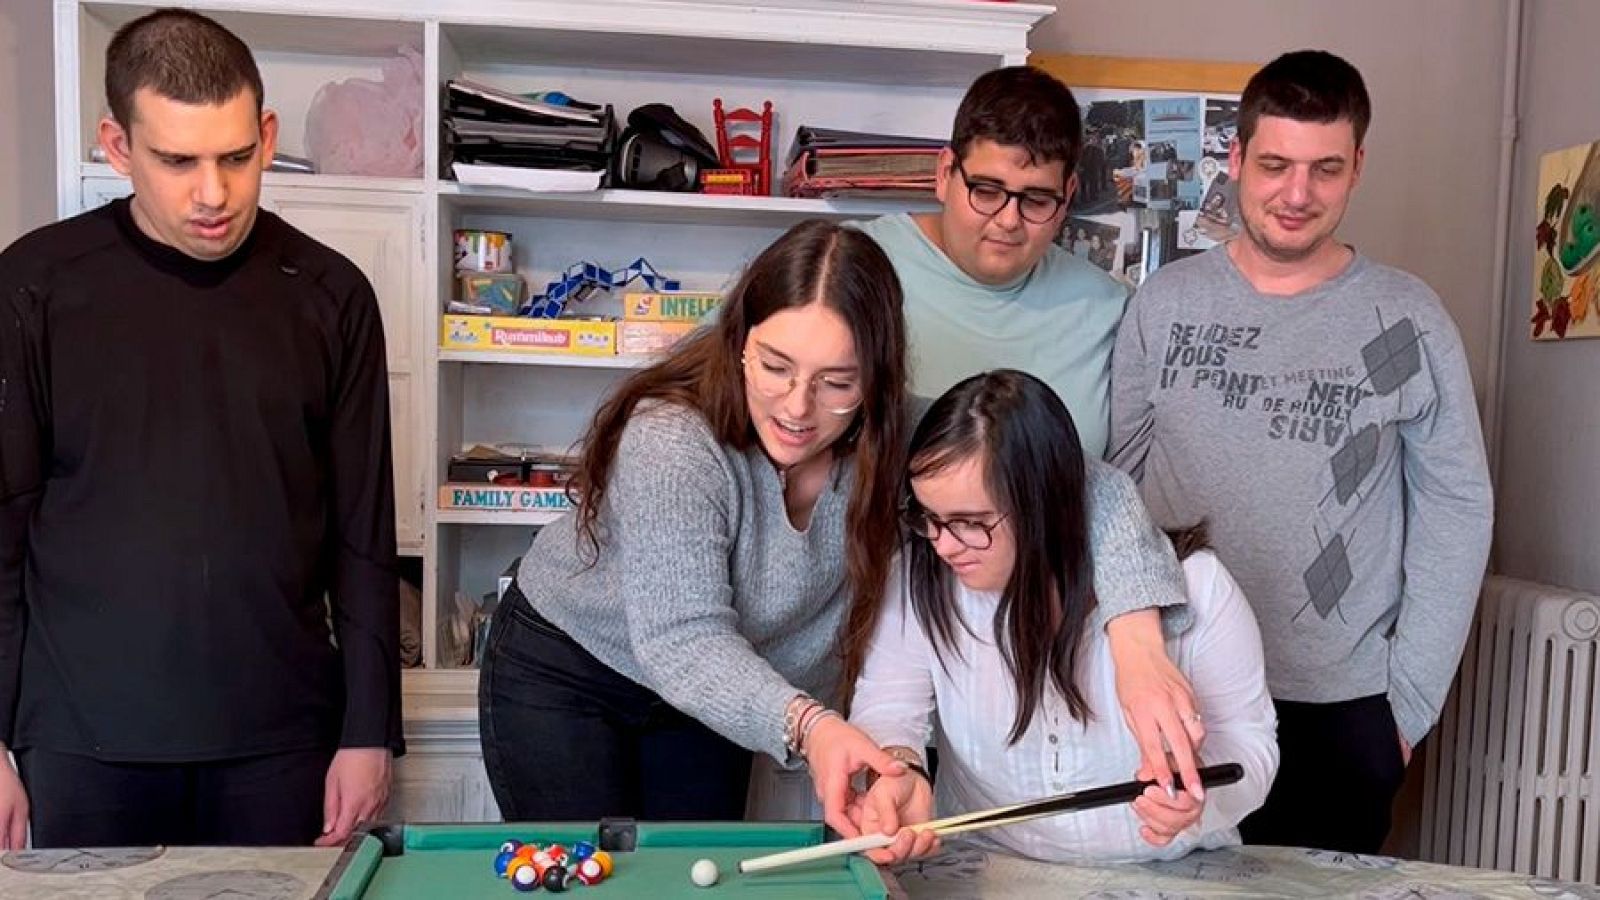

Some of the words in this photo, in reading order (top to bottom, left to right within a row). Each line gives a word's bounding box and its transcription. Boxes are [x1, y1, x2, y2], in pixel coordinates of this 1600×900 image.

[495, 329, 567, 347] Rummikub
[1165, 345, 1229, 368] VOUS
[1192, 368, 1262, 396] PONT
[1284, 366, 1355, 384] MEETING
[453, 489, 514, 506] FAMILY
[520, 490, 571, 508] GAME
